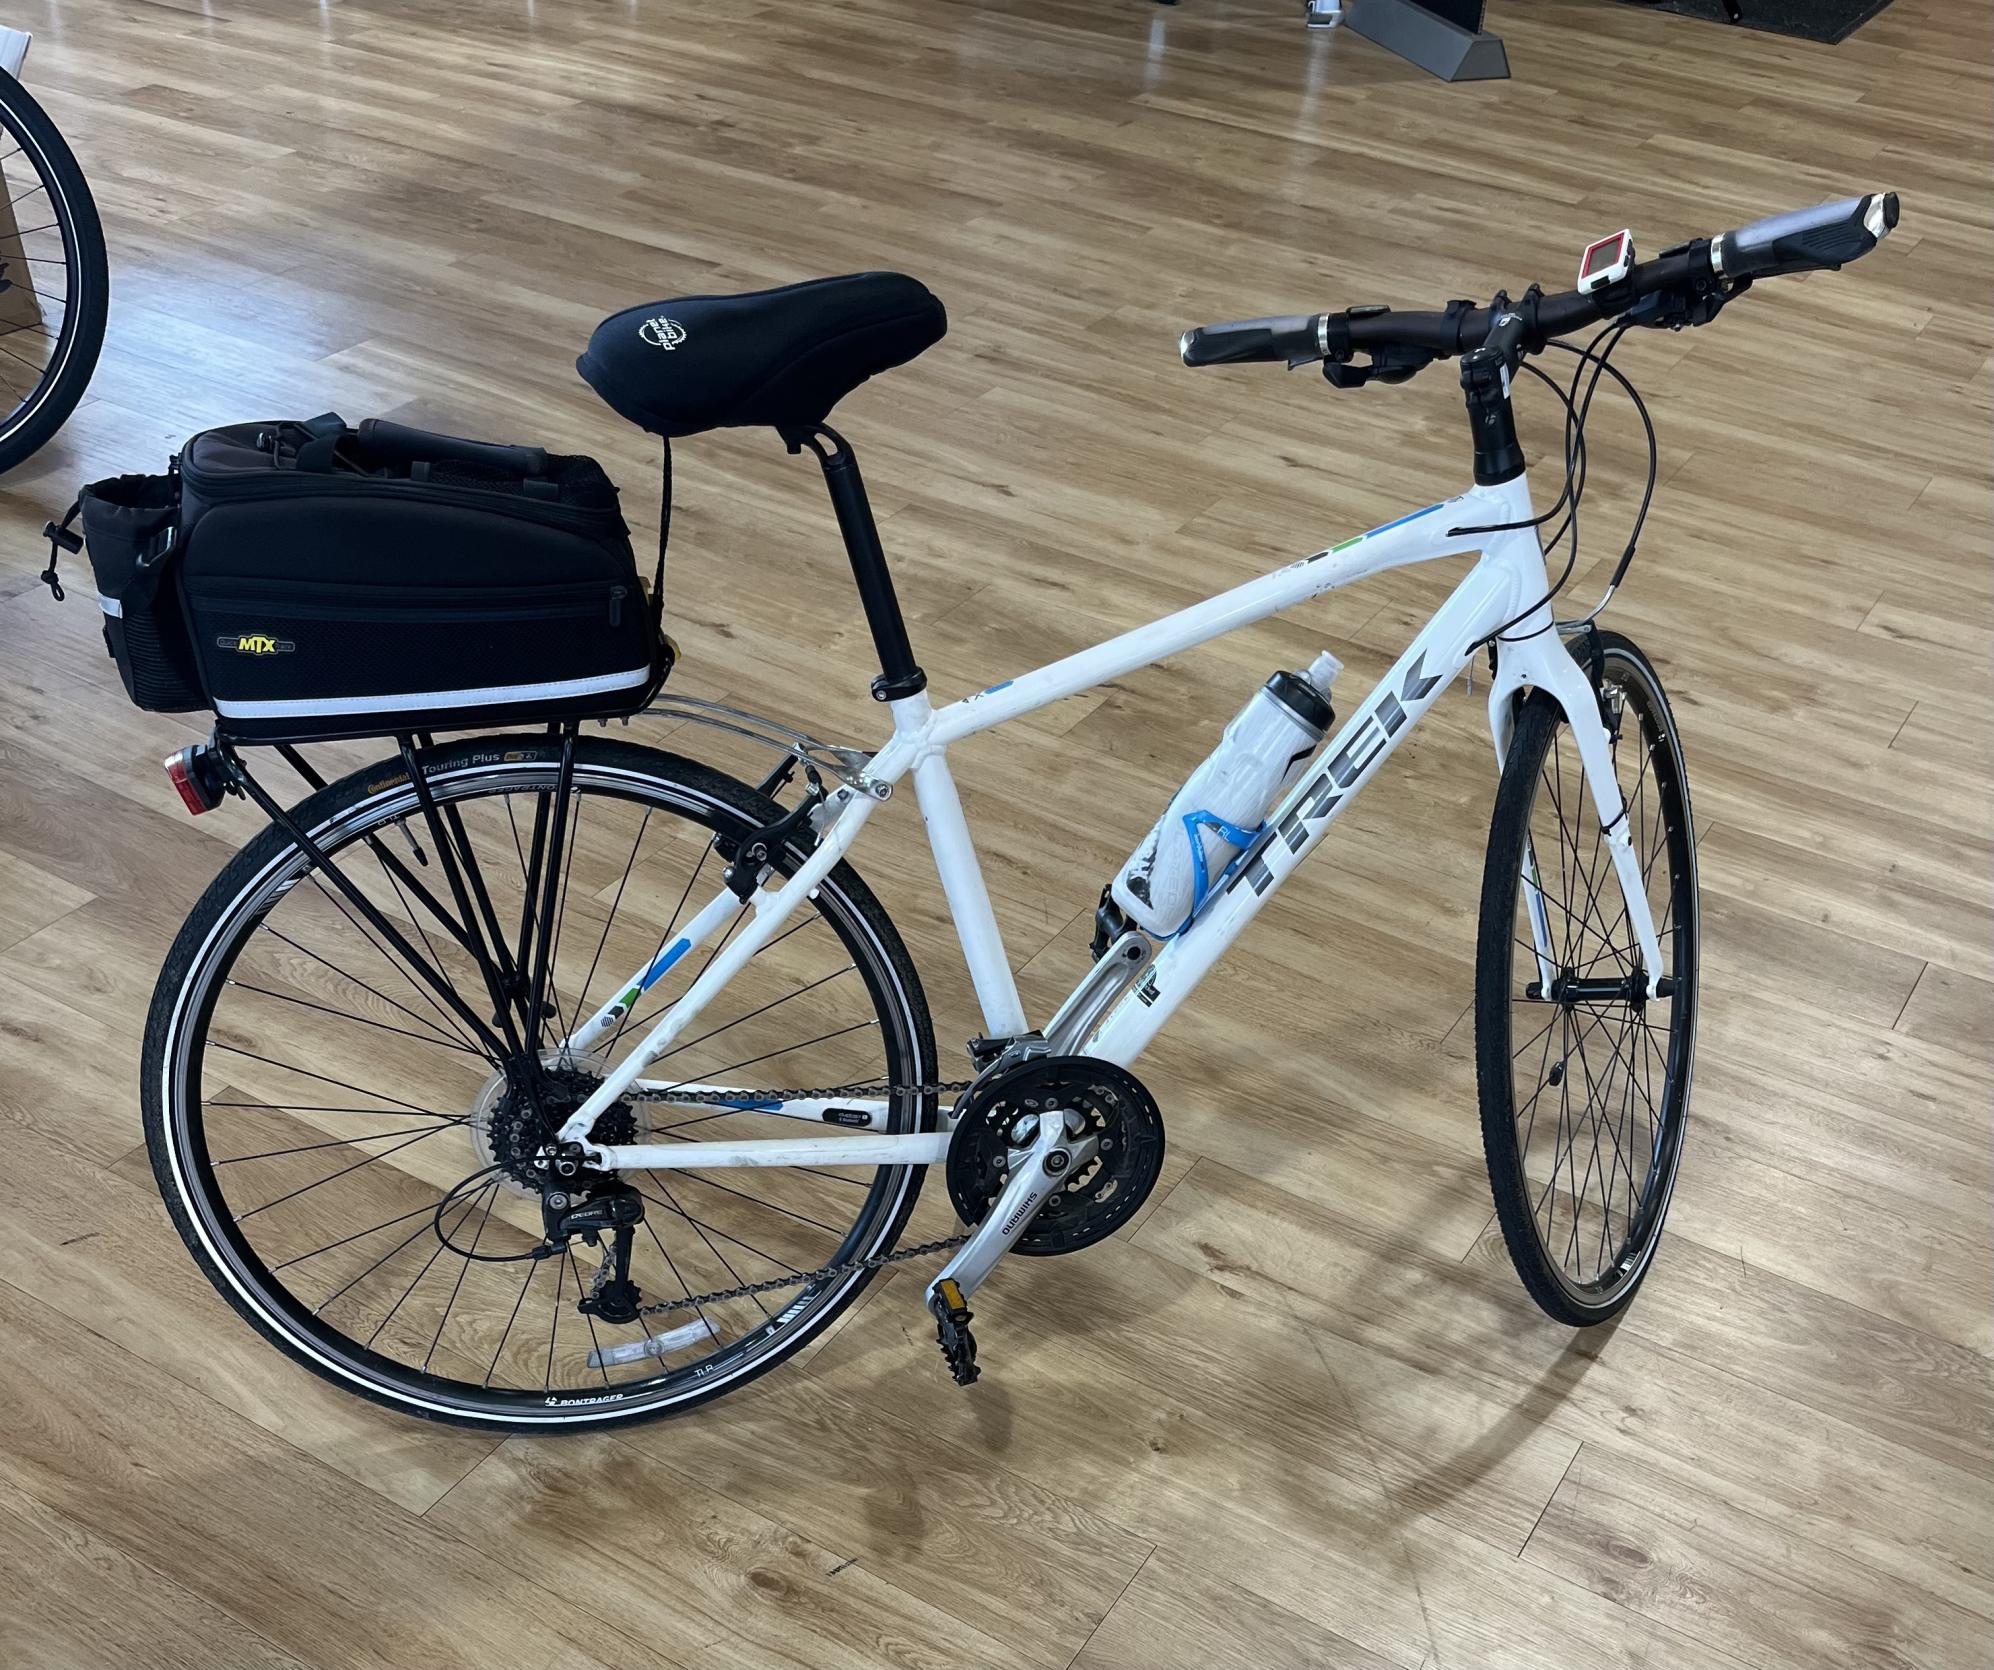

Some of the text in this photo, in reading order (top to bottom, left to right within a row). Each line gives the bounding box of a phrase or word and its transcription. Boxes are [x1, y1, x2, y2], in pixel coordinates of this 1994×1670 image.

[645, 318, 676, 351] planet
[238, 635, 276, 653] MTX
[421, 757, 469, 776] Touring
[472, 752, 501, 765] Plus
[1226, 648, 1444, 897] TREK
[488, 784, 558, 794] ONTRAGER
[1001, 1191, 1038, 1236] SHIMANO
[560, 1393, 624, 1406] BONTRAGER
